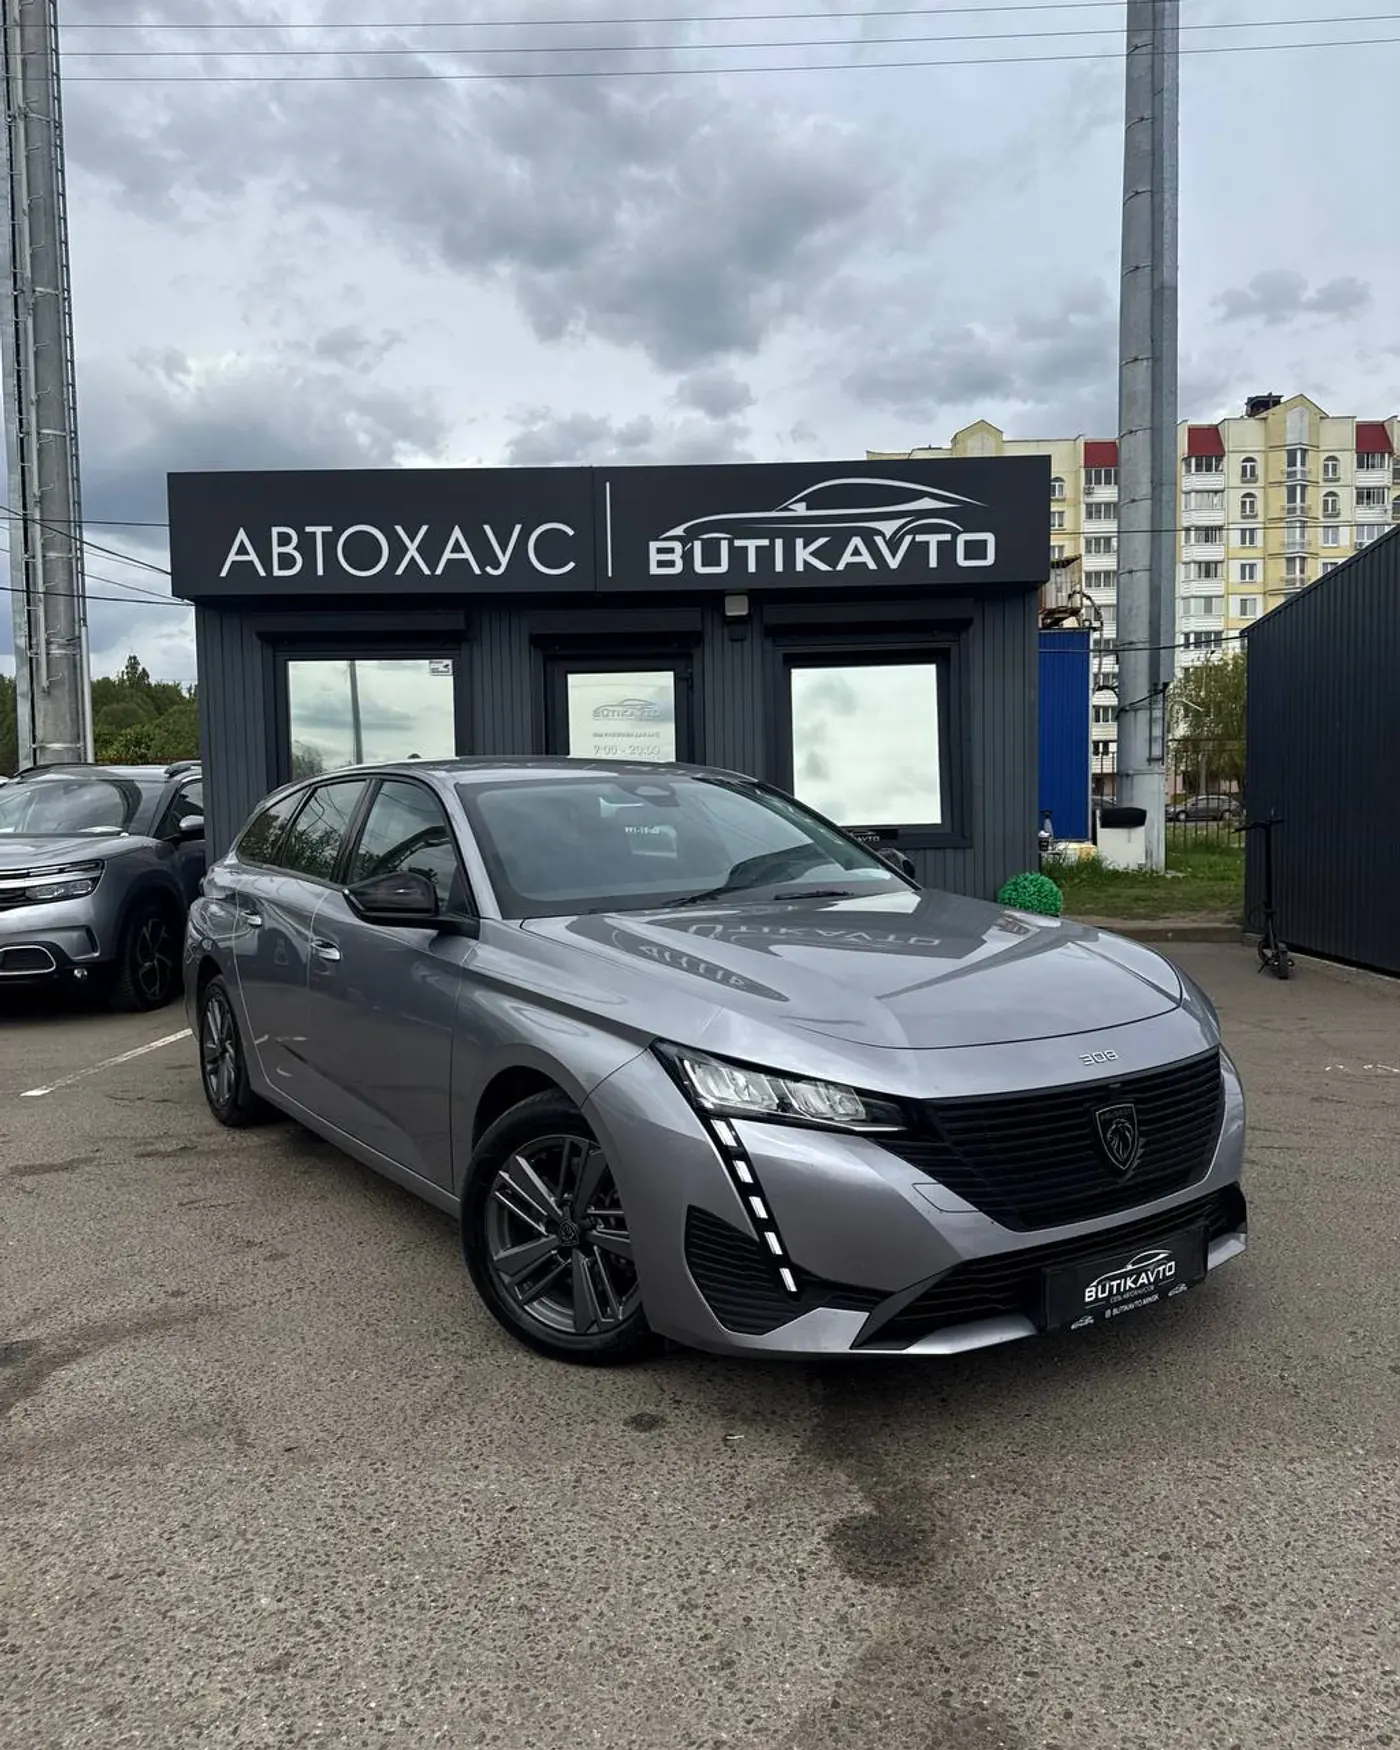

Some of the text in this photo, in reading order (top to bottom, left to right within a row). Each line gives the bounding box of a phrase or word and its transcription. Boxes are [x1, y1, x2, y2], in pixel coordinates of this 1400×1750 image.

[219, 522, 576, 578] АВТОХАУС
[648, 531, 996, 576] BUTIKAVTO
[592, 709, 660, 718] BUTIKATO
[1080, 1049, 1118, 1066] 308
[1085, 1261, 1176, 1302] BUTIKAVTO
